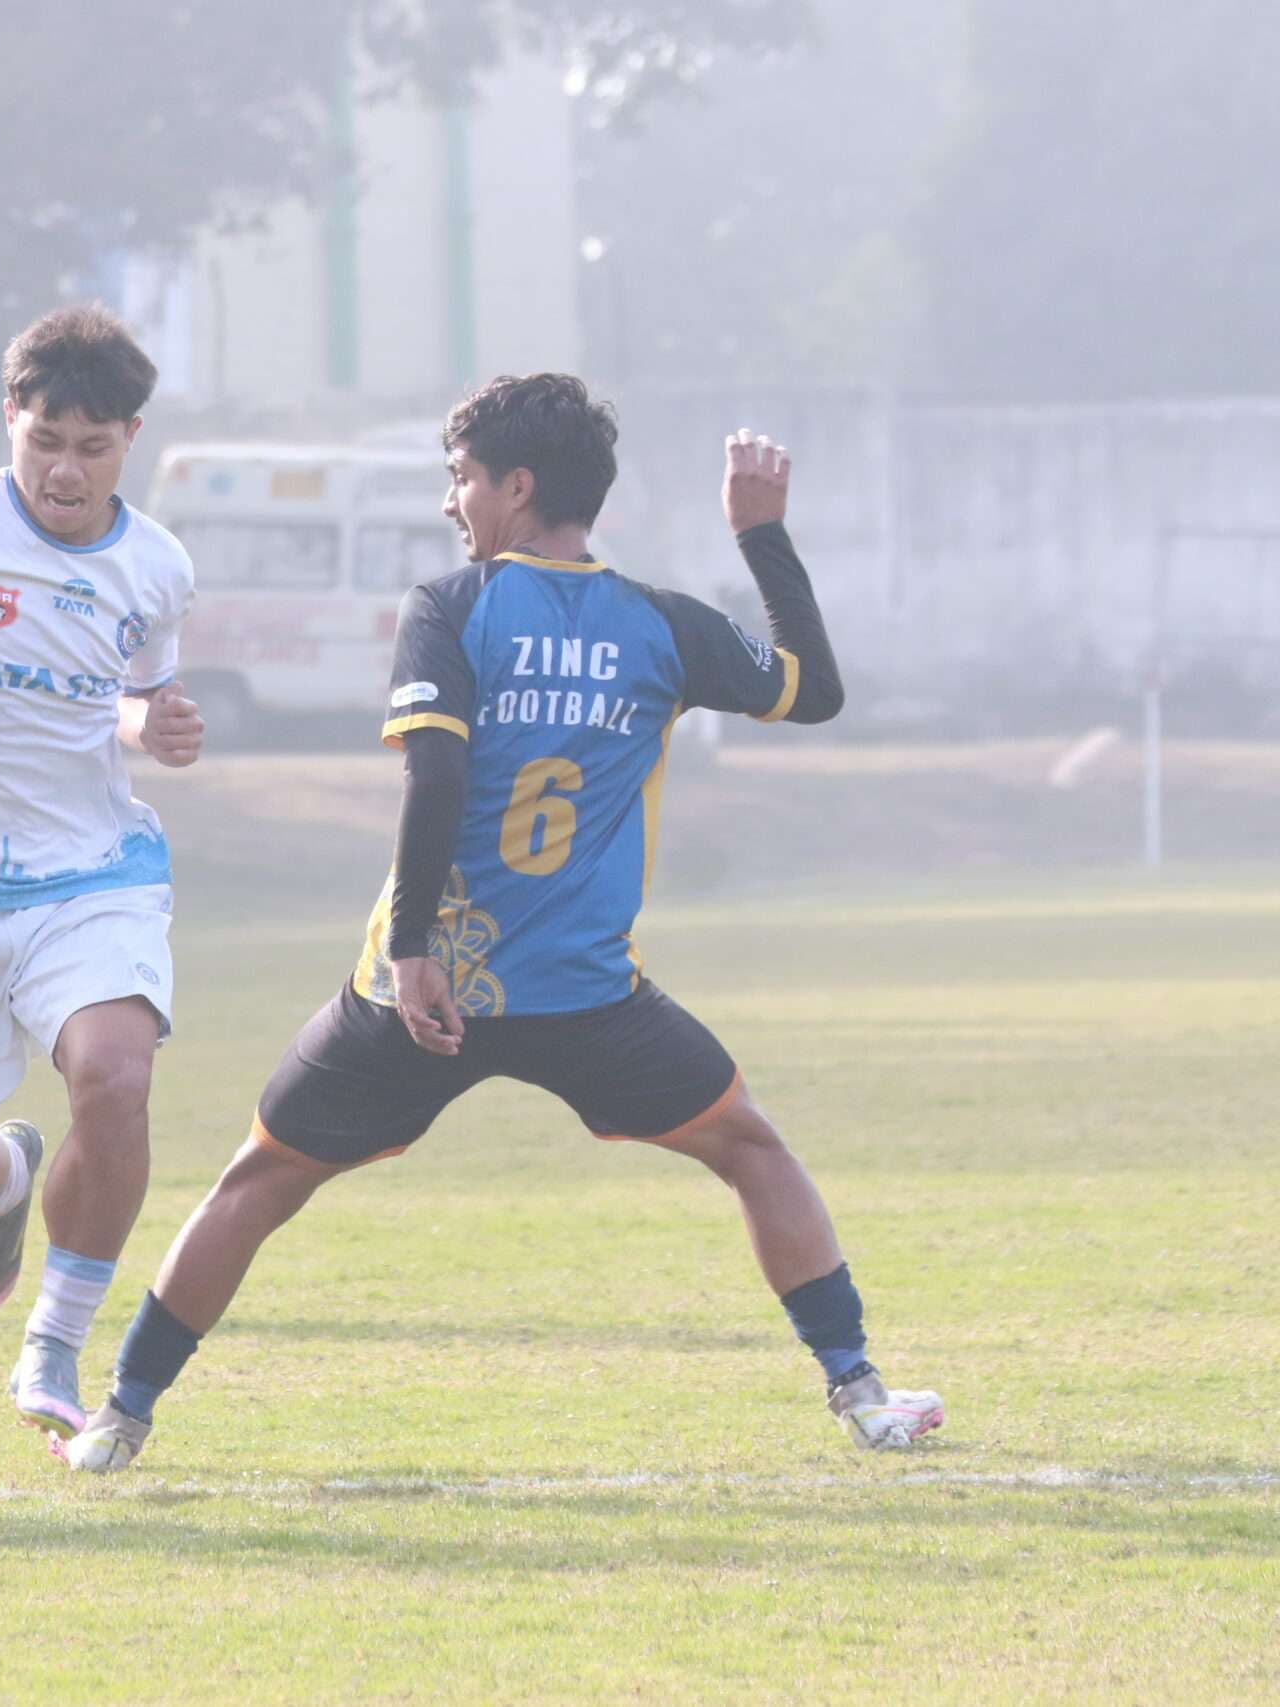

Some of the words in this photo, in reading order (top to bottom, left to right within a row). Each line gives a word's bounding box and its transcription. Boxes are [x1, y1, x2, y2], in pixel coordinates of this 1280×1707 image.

[52, 595, 95, 617] TATA
[512, 636, 619, 680] ZINC
[499, 757, 584, 876] 6
